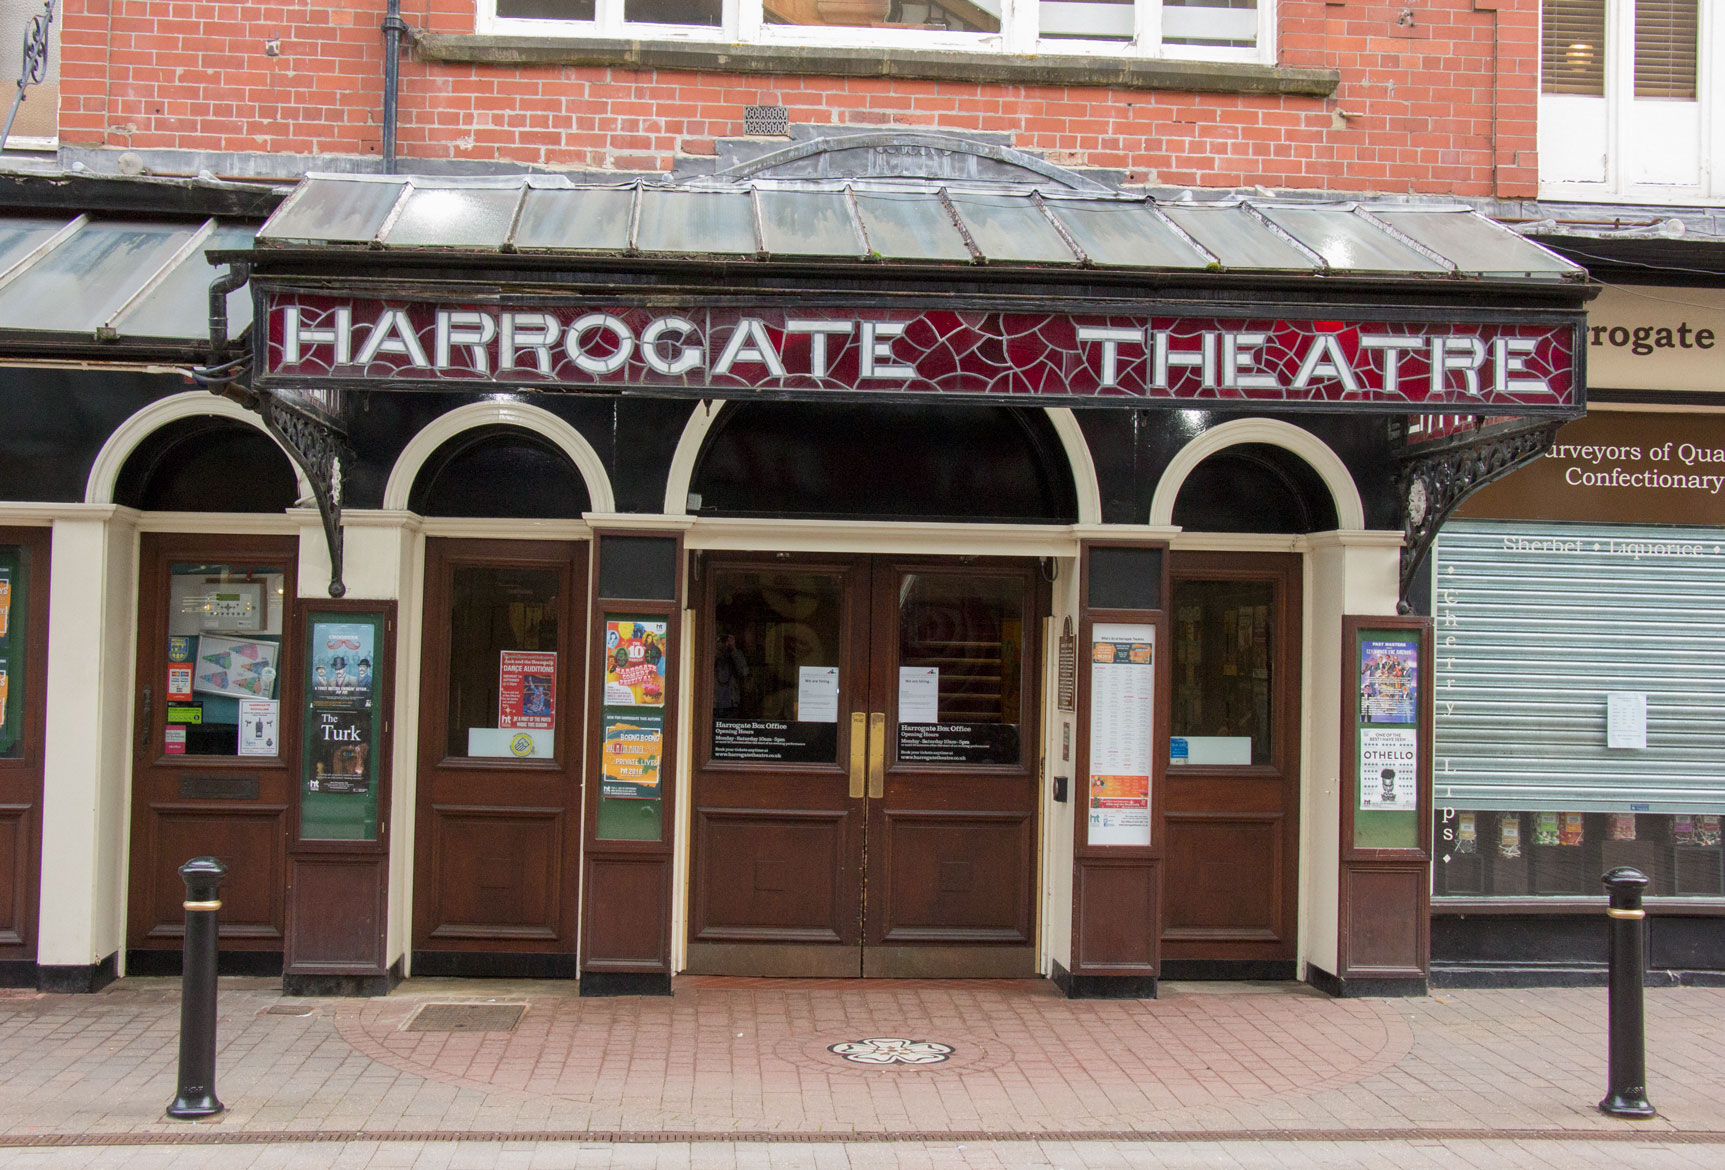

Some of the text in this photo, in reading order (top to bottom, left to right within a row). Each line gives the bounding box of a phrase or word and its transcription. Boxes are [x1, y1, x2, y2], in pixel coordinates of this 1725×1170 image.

[1587, 321, 1715, 356] rogate
[282, 305, 1553, 397] HARROGATE THEATRE
[1649, 442, 1673, 461] of
[1565, 466, 1725, 494] Confectionary
[1503, 536, 1704, 560] Sherbet Liquorice
[1444, 588, 1459, 717] Cherry
[524, 665, 554, 673] AUDITIONS
[321, 713, 338, 723] The
[715, 722, 751, 730] Harrogate
[320, 724, 362, 741] Turk
[901, 724, 936, 734] Harrogate
[1364, 750, 1413, 760] OTHELLO
